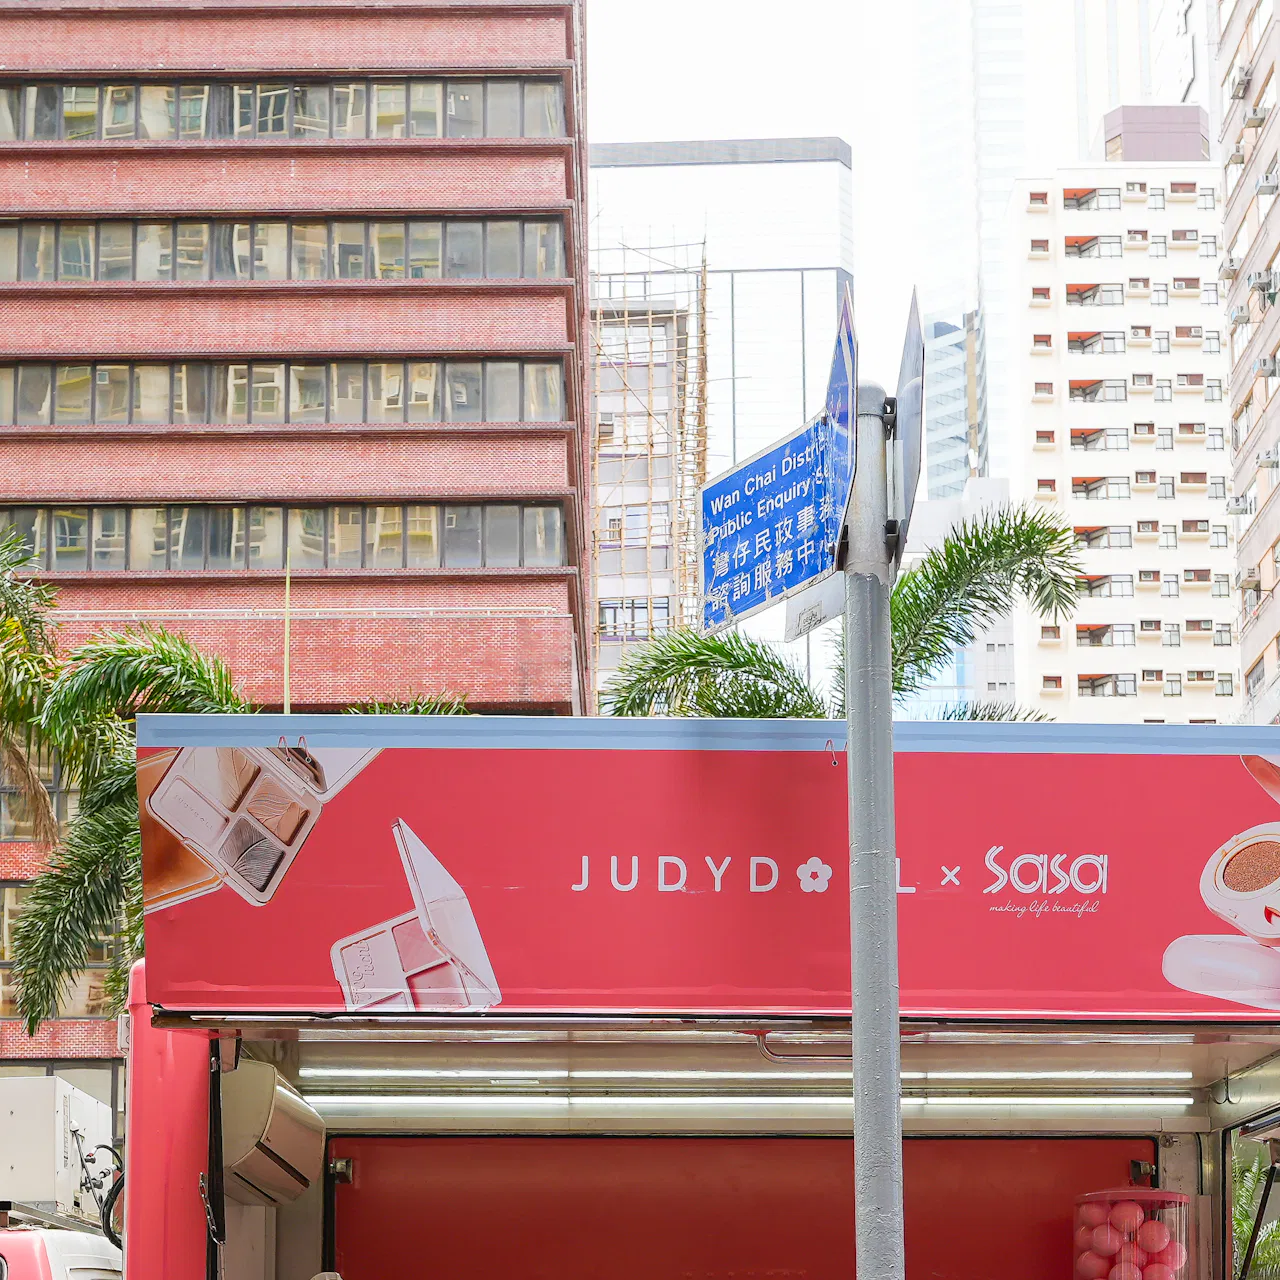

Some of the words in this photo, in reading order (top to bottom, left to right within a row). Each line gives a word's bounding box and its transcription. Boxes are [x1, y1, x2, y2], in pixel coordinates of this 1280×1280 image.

[709, 511, 753, 543] Public
[756, 478, 812, 517] Enquiry
[710, 488, 740, 516] Wan
[744, 465, 777, 496] Chai
[711, 494, 836, 577] 灣仔民政事務
[570, 854, 917, 894] JUDYDOL
[982, 845, 1109, 896] Sasa
[989, 903, 1028, 919] making
[1028, 901, 1051, 918] life
[1051, 901, 1100, 918] beautiful
